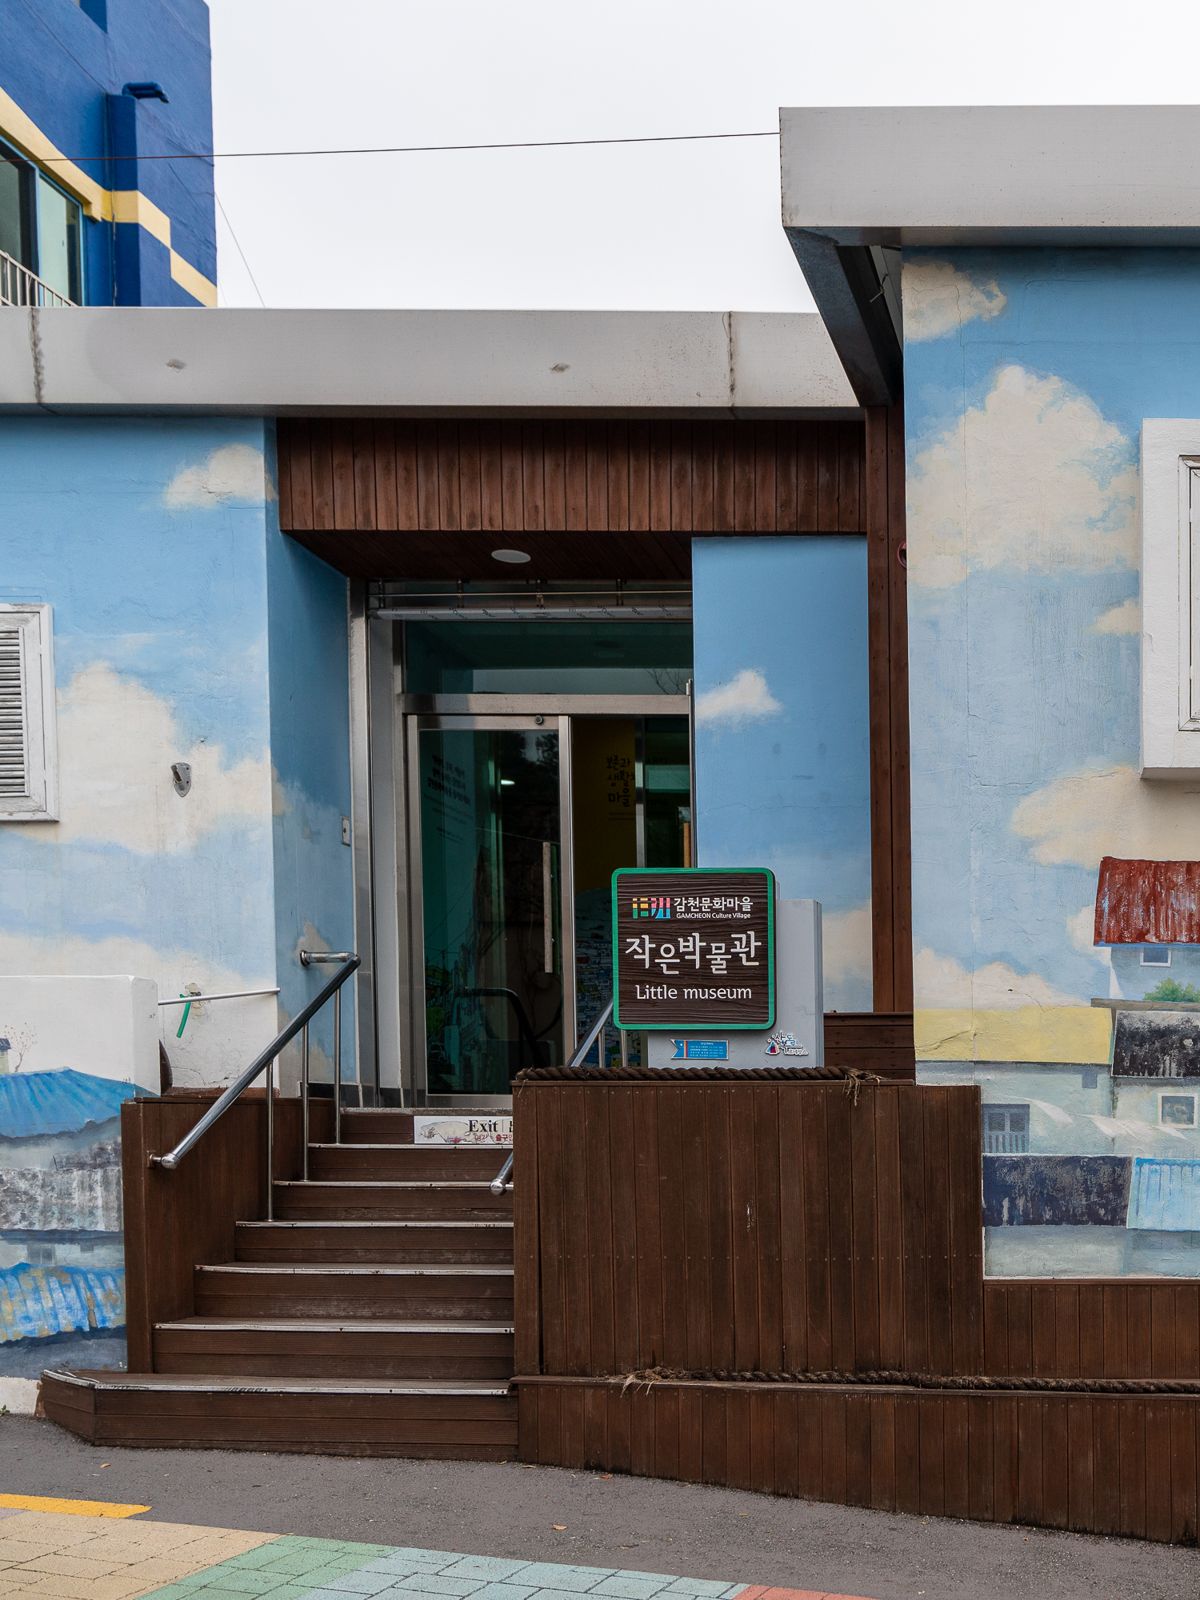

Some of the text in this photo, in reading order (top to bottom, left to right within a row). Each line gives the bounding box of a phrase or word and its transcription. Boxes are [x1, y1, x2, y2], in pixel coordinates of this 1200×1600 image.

[673, 896, 754, 912] 감천문화마을
[732, 912, 751, 920] Village
[625, 931, 762, 975] 작은박물관
[635, 984, 752, 1000] Little museum
[468, 1119, 498, 1132] Exit
